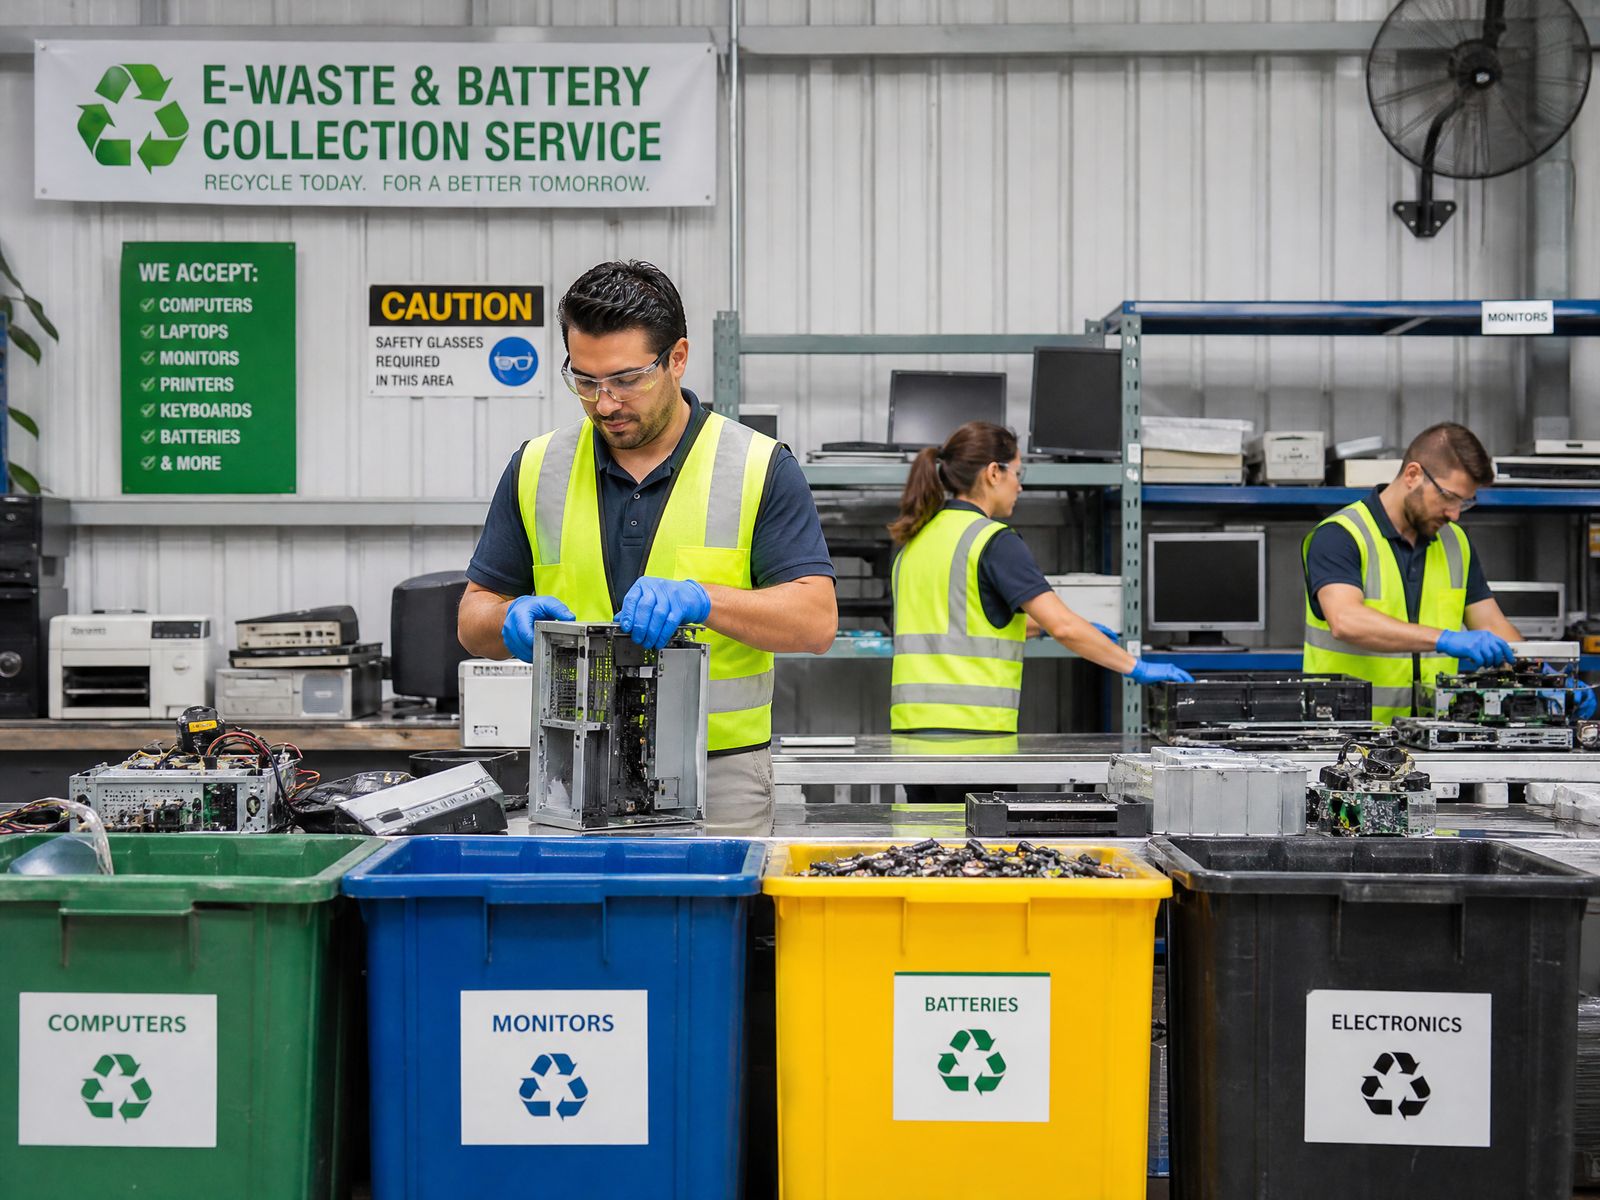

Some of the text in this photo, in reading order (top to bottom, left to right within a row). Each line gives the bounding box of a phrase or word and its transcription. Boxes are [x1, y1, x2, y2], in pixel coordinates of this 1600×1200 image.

[204, 65, 650, 106] E-WASTE & BATTERY
[204, 120, 661, 161] COLLECTION SERVICE
[205, 175, 649, 192] RECYCLE TODAY. FOR A BETTER TOMORROW.
[139, 263, 258, 282] WE ACCEPT:
[160, 298, 253, 313] COMPUTERS
[382, 292, 532, 320] CAUTION
[1488, 312, 1548, 322] MONITORS
[160, 324, 229, 340] LAPTOPS
[376, 337, 484, 349] SAFETY GLASSES
[160, 351, 240, 366] MONITORS
[376, 356, 440, 368] REQUIRED
[161, 377, 235, 392] PRINTERS
[376, 375, 454, 386] IN THIS AREA
[161, 403, 253, 418] KEYBOARDS
[161, 429, 241, 444] BATTERIES
[161, 456, 222, 470] & MORE
[926, 997, 1019, 1013] BATTERIES
[49, 1015, 187, 1033] COMPUTERS
[494, 1015, 615, 1032] MONITORS
[1333, 1014, 1463, 1033] ELECTRONICS
